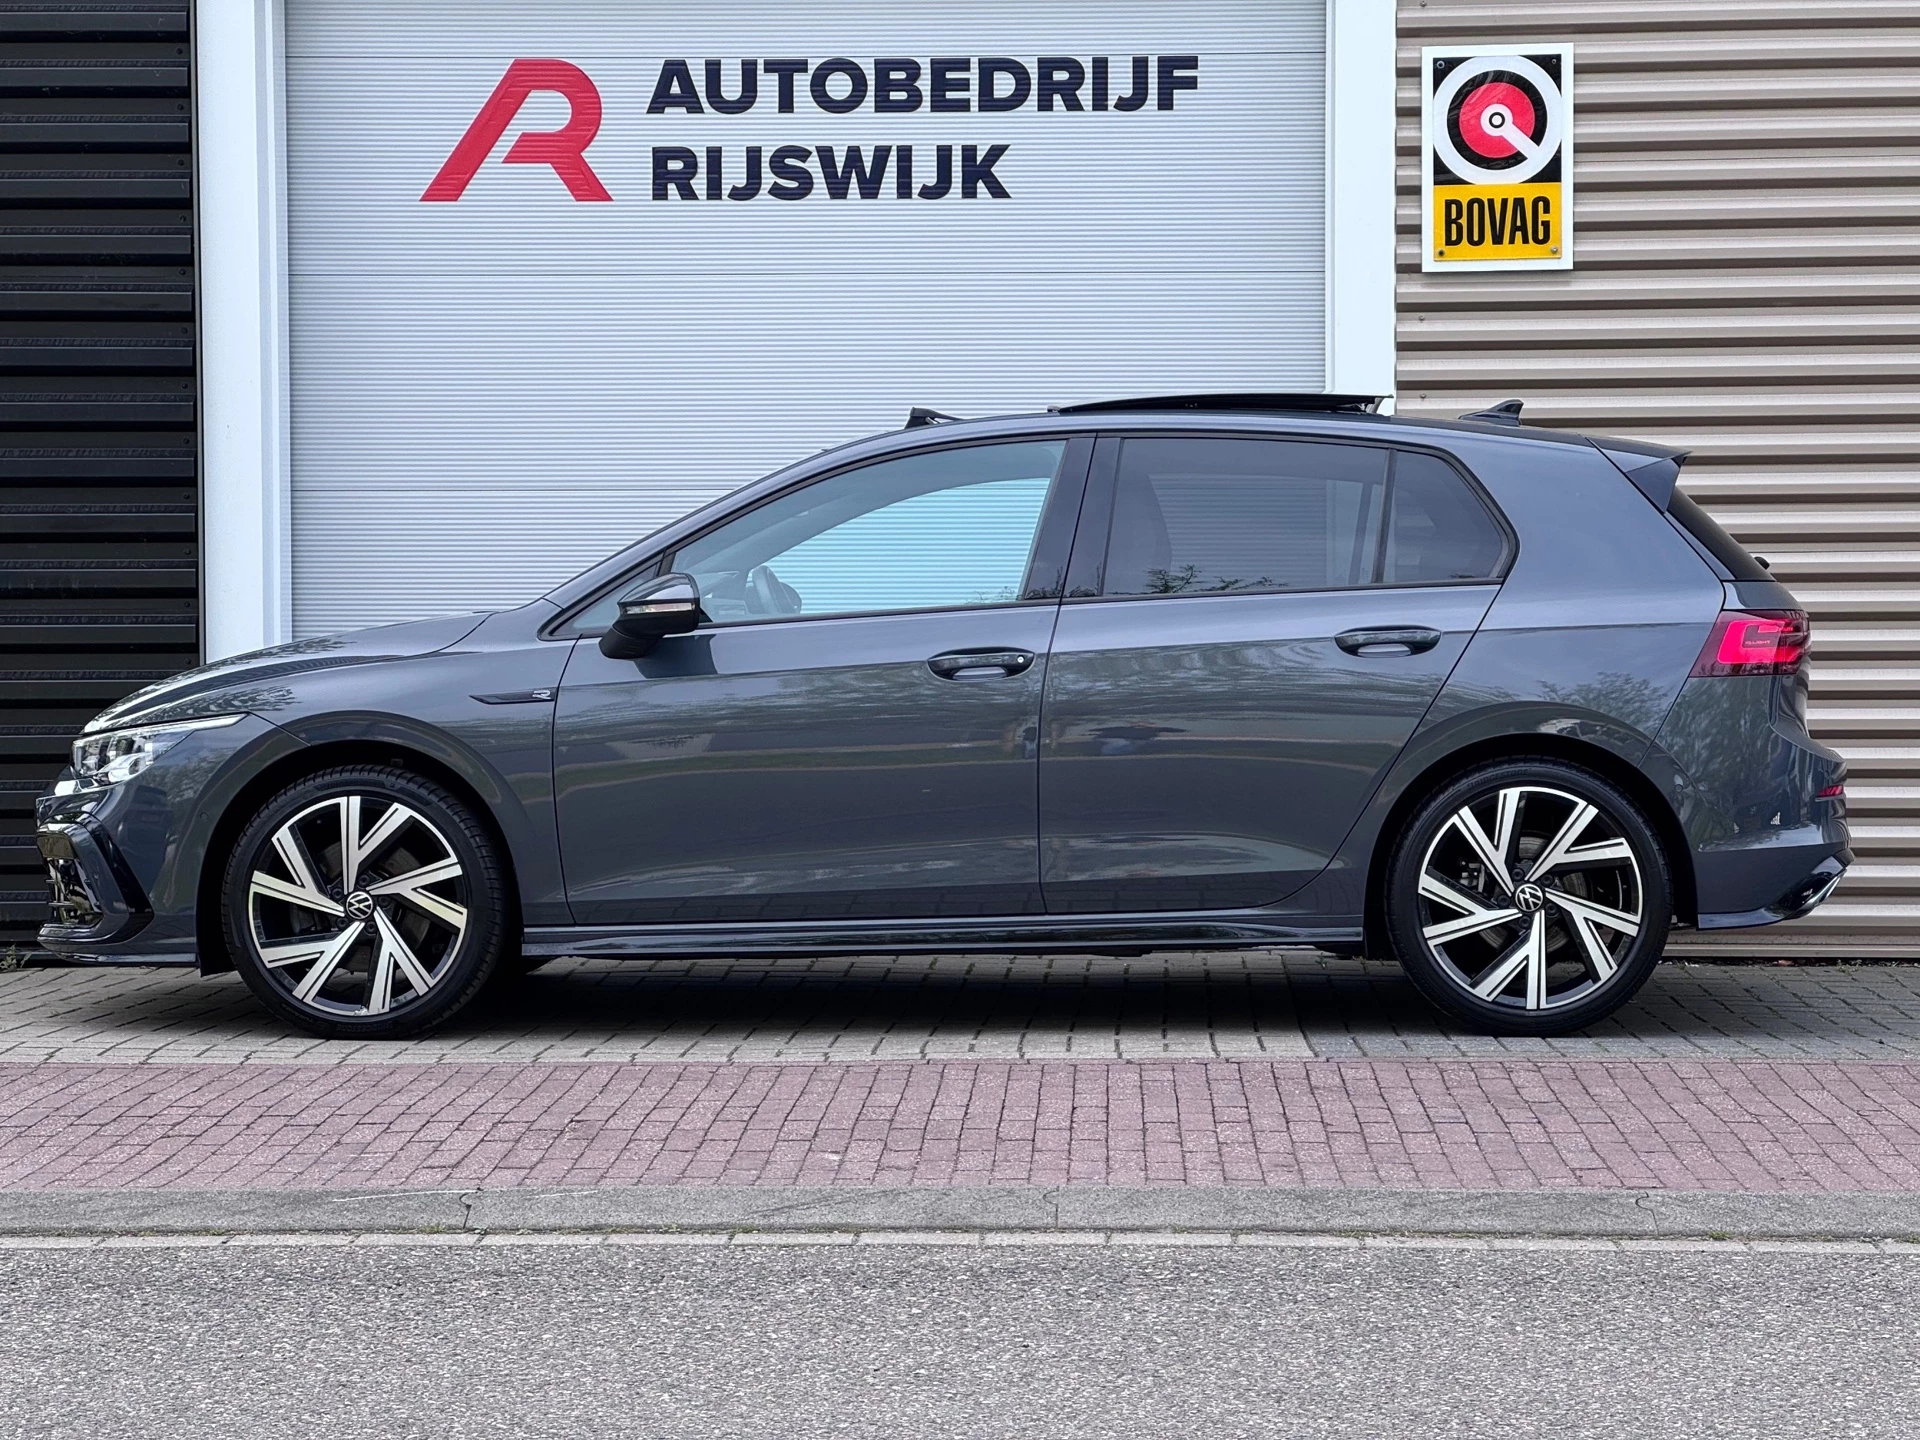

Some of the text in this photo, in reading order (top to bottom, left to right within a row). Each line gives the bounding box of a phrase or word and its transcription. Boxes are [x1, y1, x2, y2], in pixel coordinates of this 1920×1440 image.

[647, 55, 1199, 115] AUTOBEDRIJF
[651, 144, 1011, 202] RIJSWIJK
[1444, 196, 1551, 246] BOVAG
